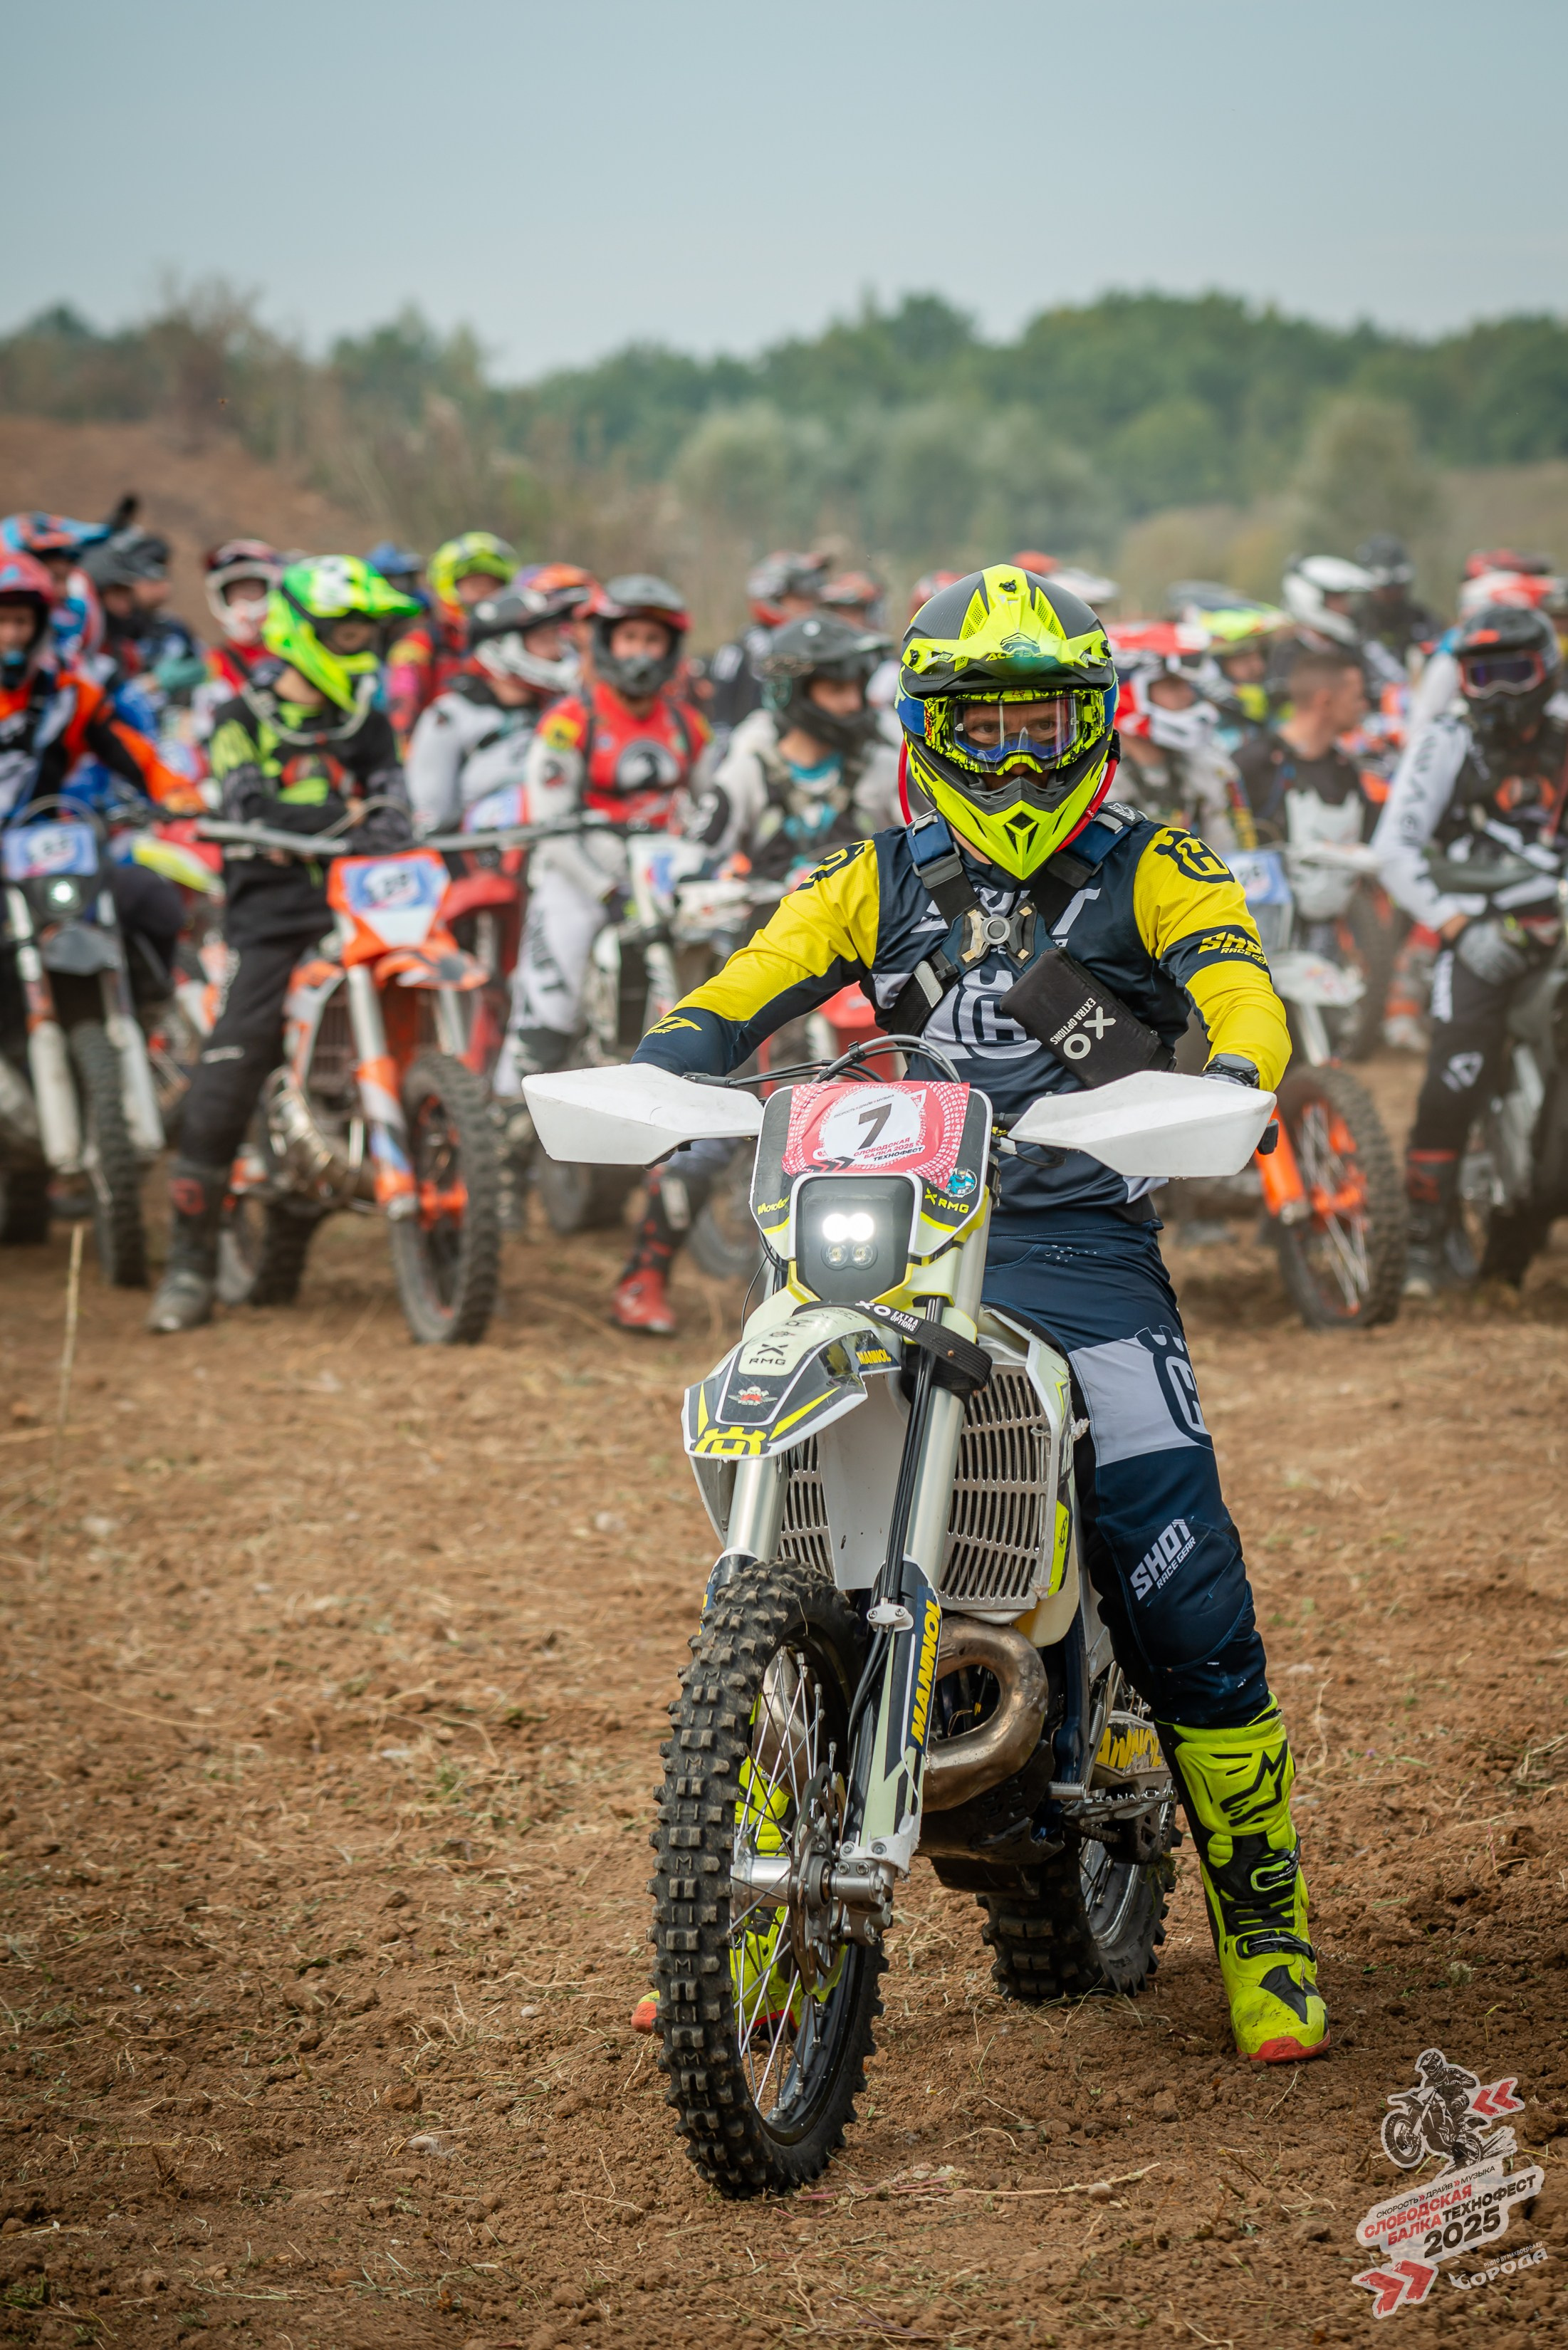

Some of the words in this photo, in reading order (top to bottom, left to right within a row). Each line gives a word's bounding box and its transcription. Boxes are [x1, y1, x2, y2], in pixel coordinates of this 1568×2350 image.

[1198, 931, 1265, 956] SHO
[1251, 954, 1268, 966] GEA
[1073, 997, 1097, 1020] EXTRA
[1050, 1018, 1078, 1045] OPTIONS
[857, 1103, 892, 1151] 7
[853, 1137, 910, 1156] СЛОБОДСКАЯ
[864, 1148, 892, 1159] БАЛКА
[893, 1142, 914, 1152] 2025
[873, 1147, 924, 1161] ТЕХНОФЕСТ
[938, 1198, 969, 1213] RMG
[890, 1315, 916, 1332] OPTIONS
[893, 1311, 919, 1326] EXTRA
[748, 1357, 786, 1366] RMG
[856, 1349, 892, 1365] MANNOL
[1129, 1518, 1192, 1601] SHOT
[1156, 1560, 1180, 1589] RACE
[1176, 1536, 1197, 1563] GEAR
[910, 1599, 942, 1747] MANNOL
[1096, 1728, 1163, 1768] ANNOL
